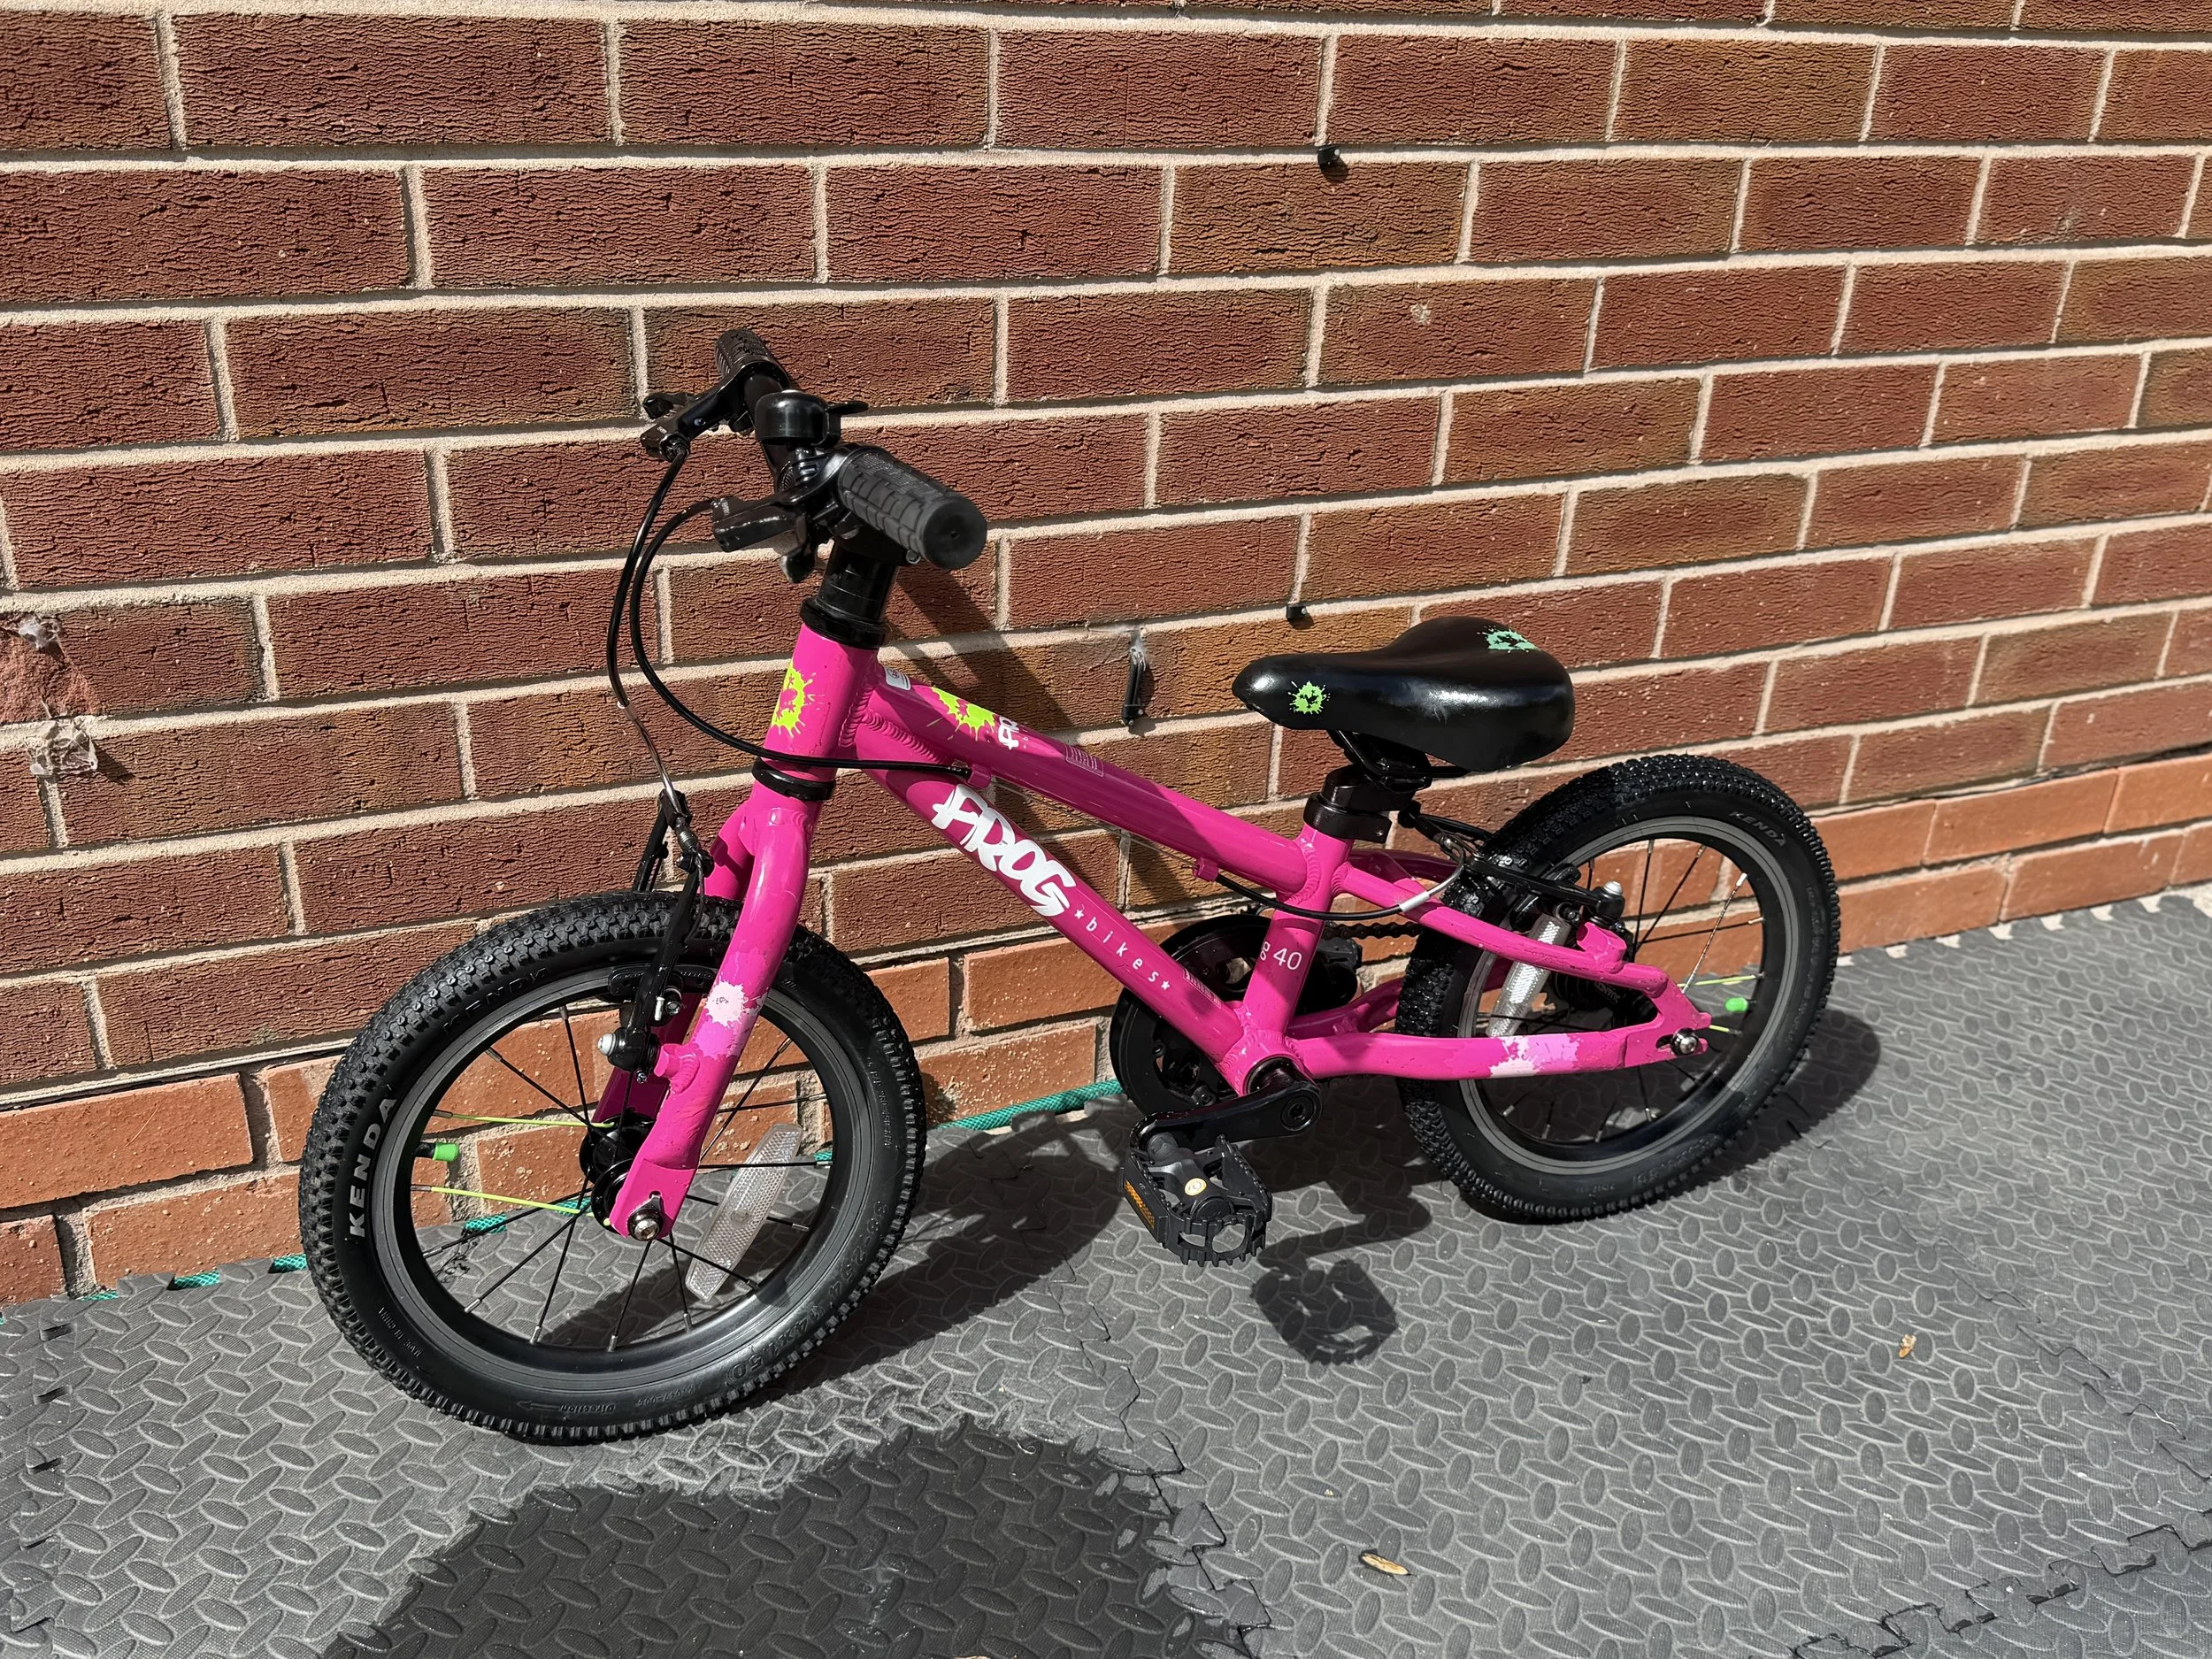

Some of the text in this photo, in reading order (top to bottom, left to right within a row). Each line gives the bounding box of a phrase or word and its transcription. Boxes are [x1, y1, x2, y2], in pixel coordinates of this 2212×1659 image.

[1729, 810, 1786, 848] KENDA
[932, 784, 1160, 983] FROG bikes
[1272, 948, 1302, 971] 40
[349, 1098, 397, 1238] KENDA
